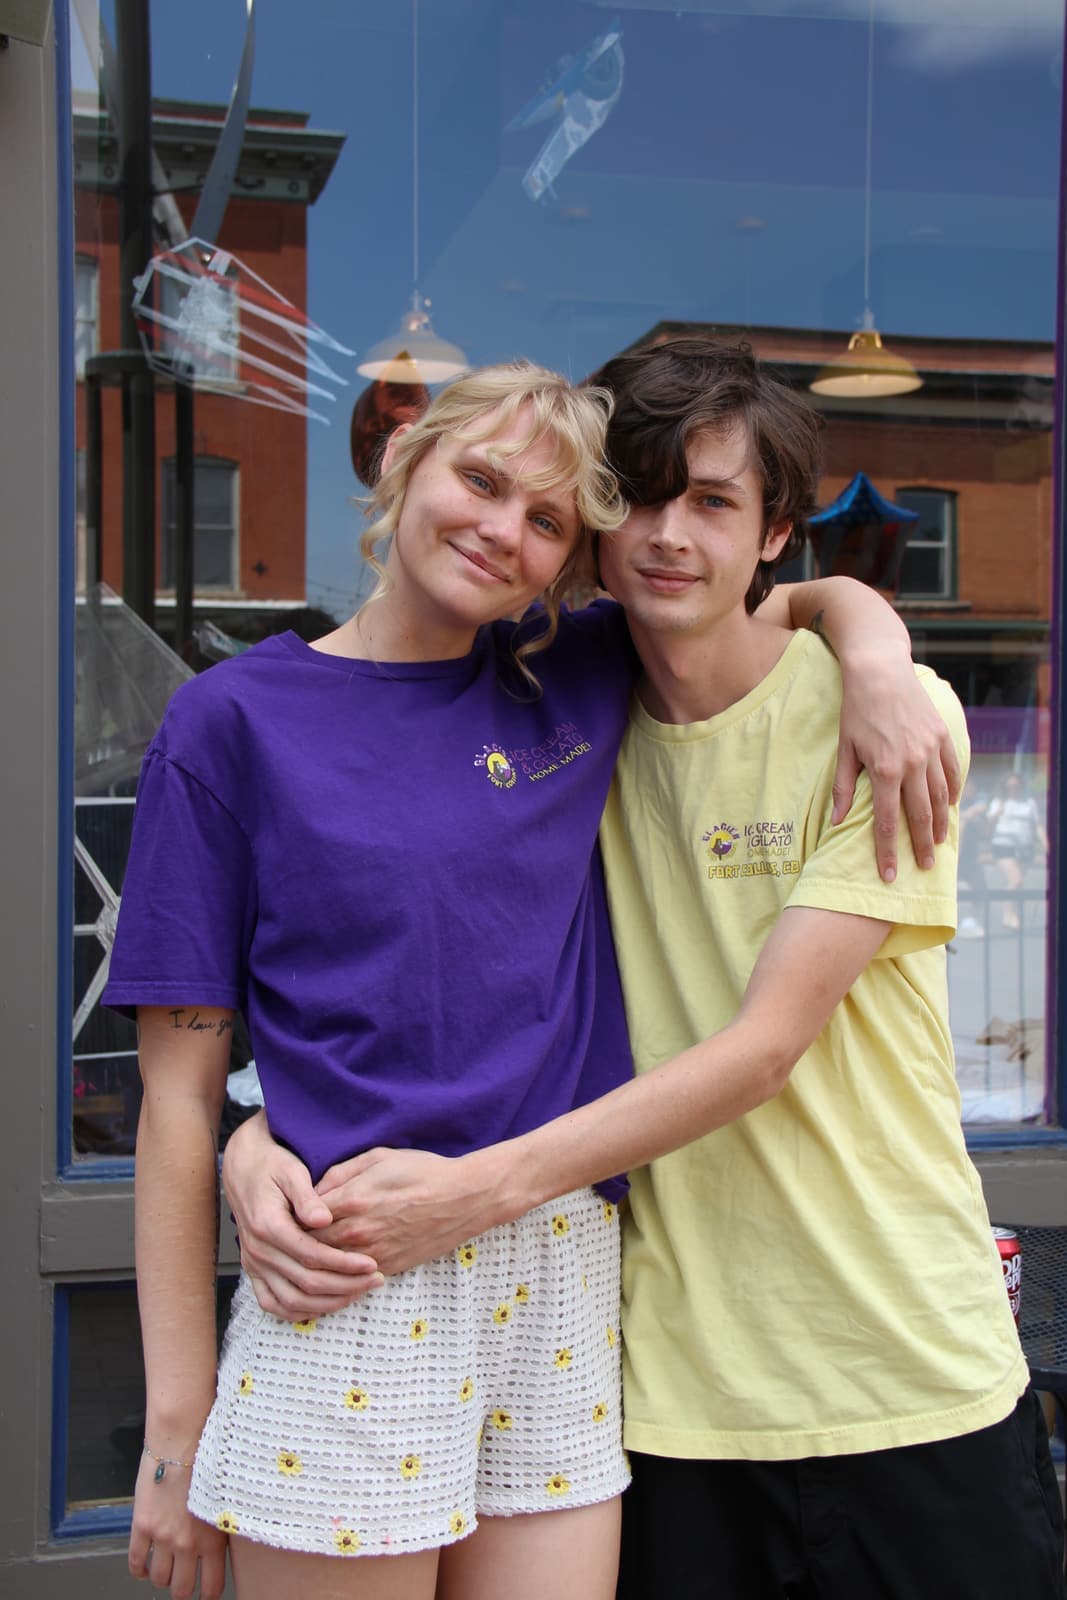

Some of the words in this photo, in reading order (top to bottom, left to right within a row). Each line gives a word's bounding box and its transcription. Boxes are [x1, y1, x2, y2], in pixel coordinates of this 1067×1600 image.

[474, 743, 513, 767] GLACI
[528, 763, 560, 782] HOME
[702, 822, 742, 842] GLACIER
[756, 821, 794, 836] CREAM
[708, 864, 740, 879] FORT
[168, 1008, 185, 1028] I
